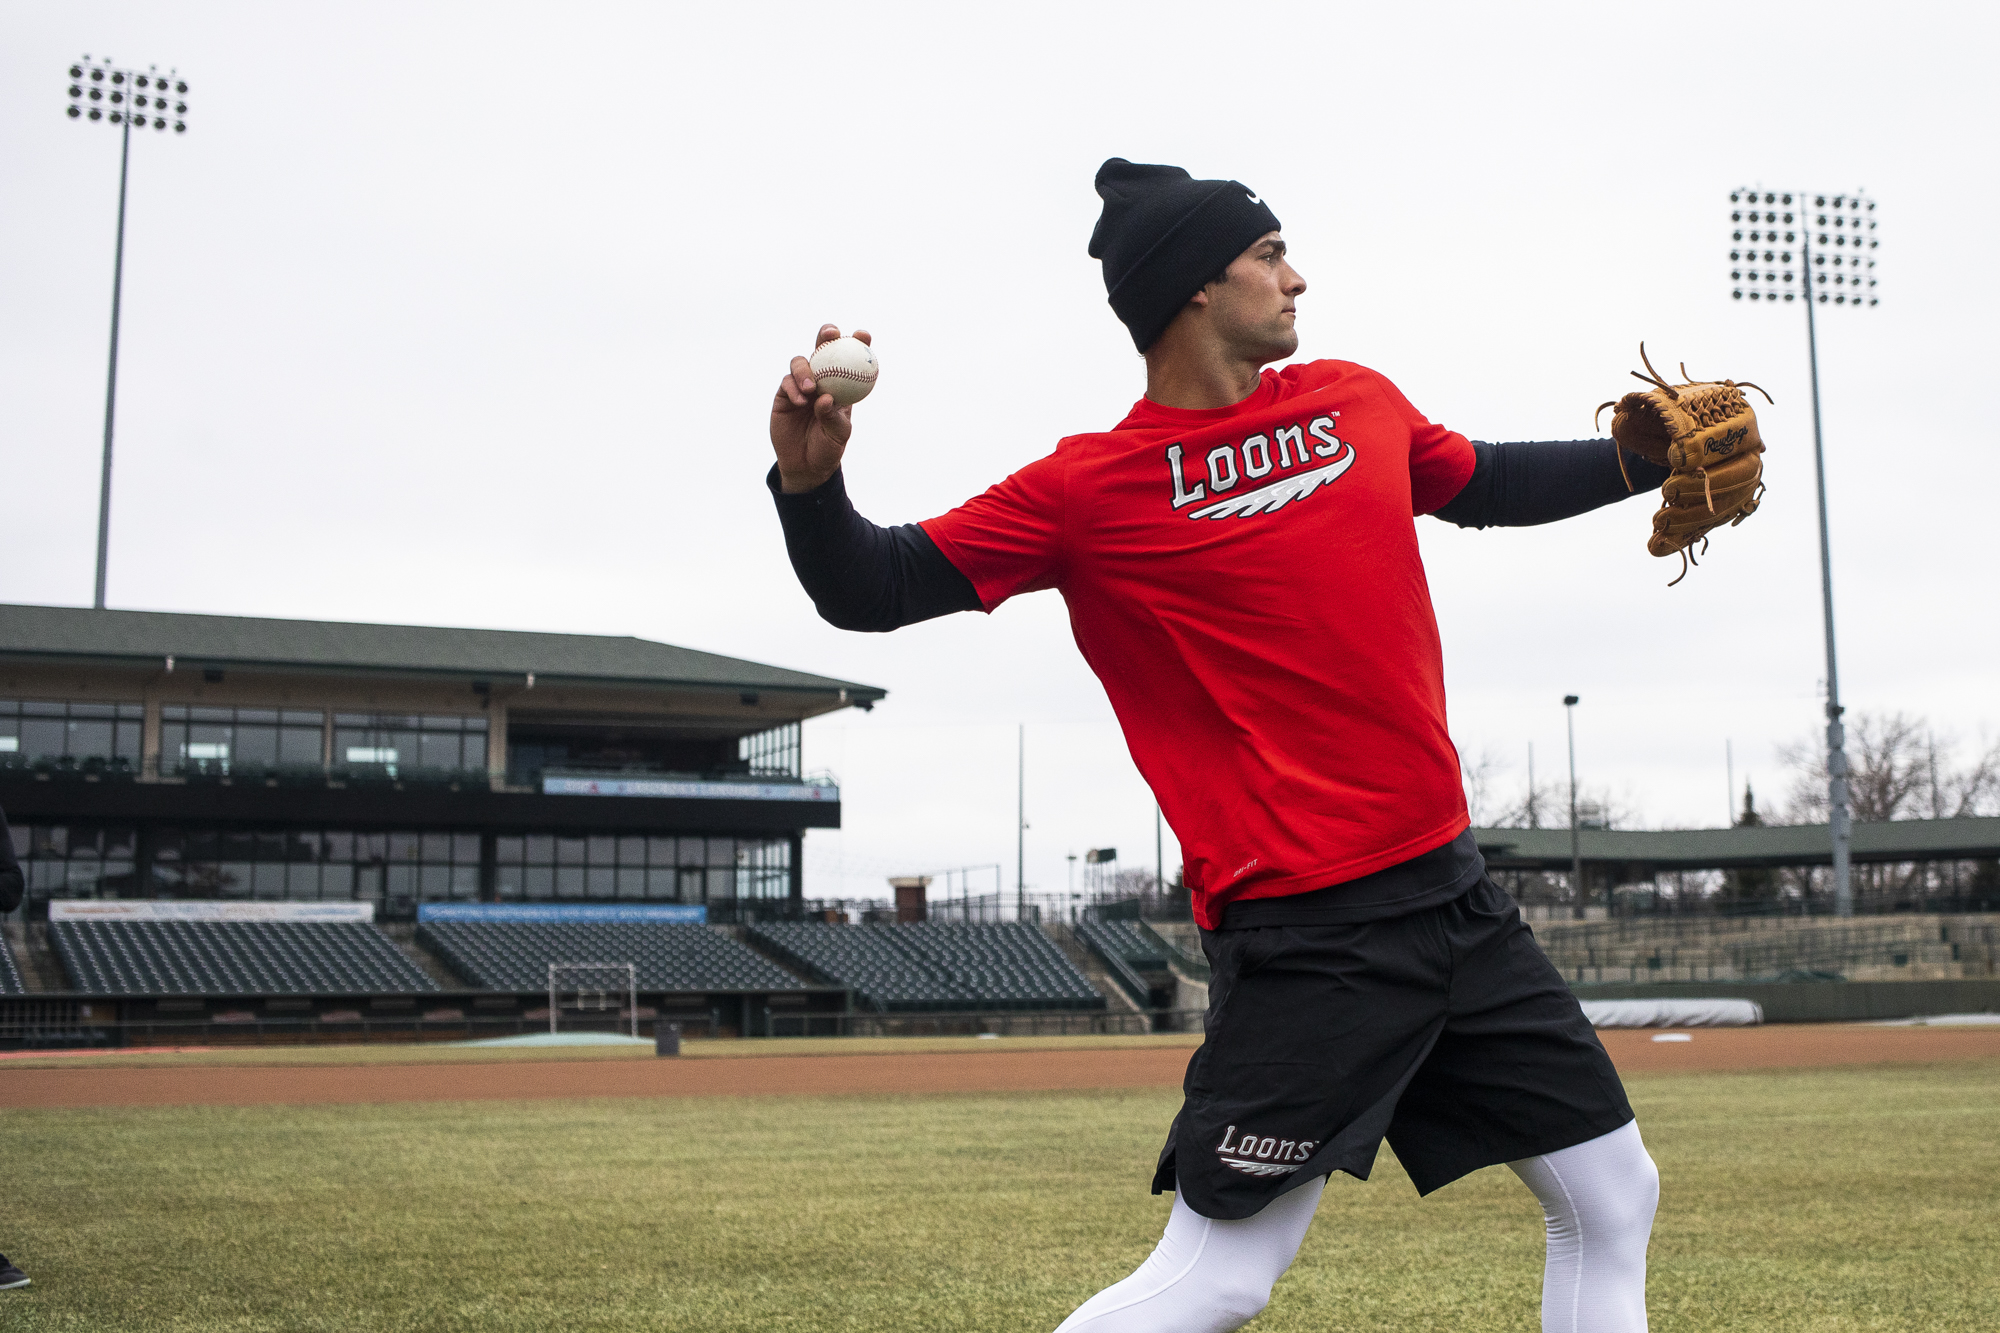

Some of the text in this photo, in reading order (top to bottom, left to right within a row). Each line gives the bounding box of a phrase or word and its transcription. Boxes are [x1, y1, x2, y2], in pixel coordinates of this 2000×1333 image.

[1704, 425, 1748, 456] Rawlings
[1165, 415, 1342, 511] Loons
[1217, 1125, 1314, 1161] Loons
